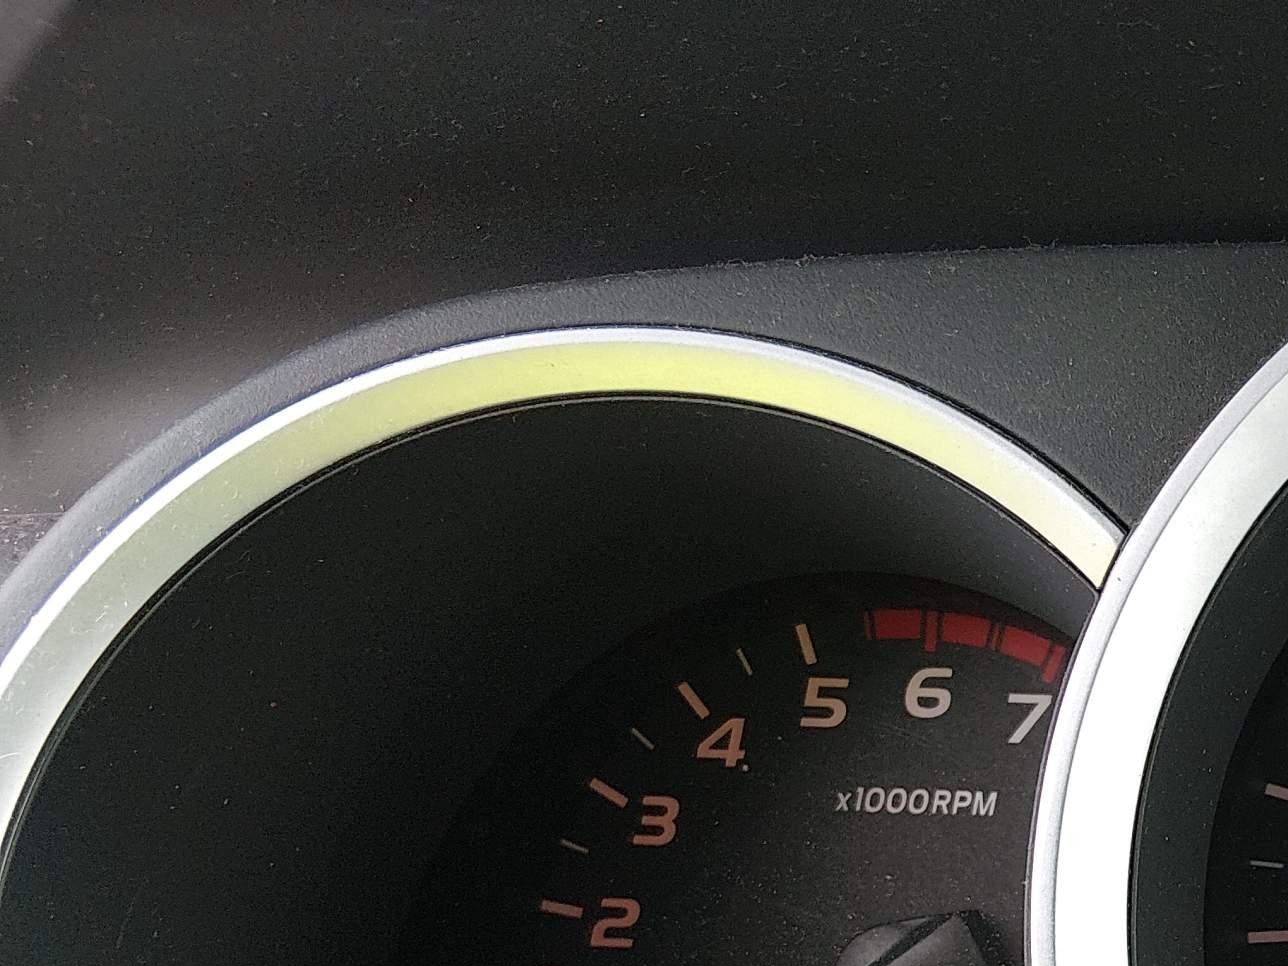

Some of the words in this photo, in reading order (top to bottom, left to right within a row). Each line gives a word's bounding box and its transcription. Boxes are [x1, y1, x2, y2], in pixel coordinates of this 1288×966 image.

[800, 677, 850, 728] 5
[904, 667, 954, 719] 6
[1007, 693, 1053, 744] 7
[697, 717, 747, 767] 4
[632, 796, 680, 846] 3
[590, 898, 641, 949] 2
